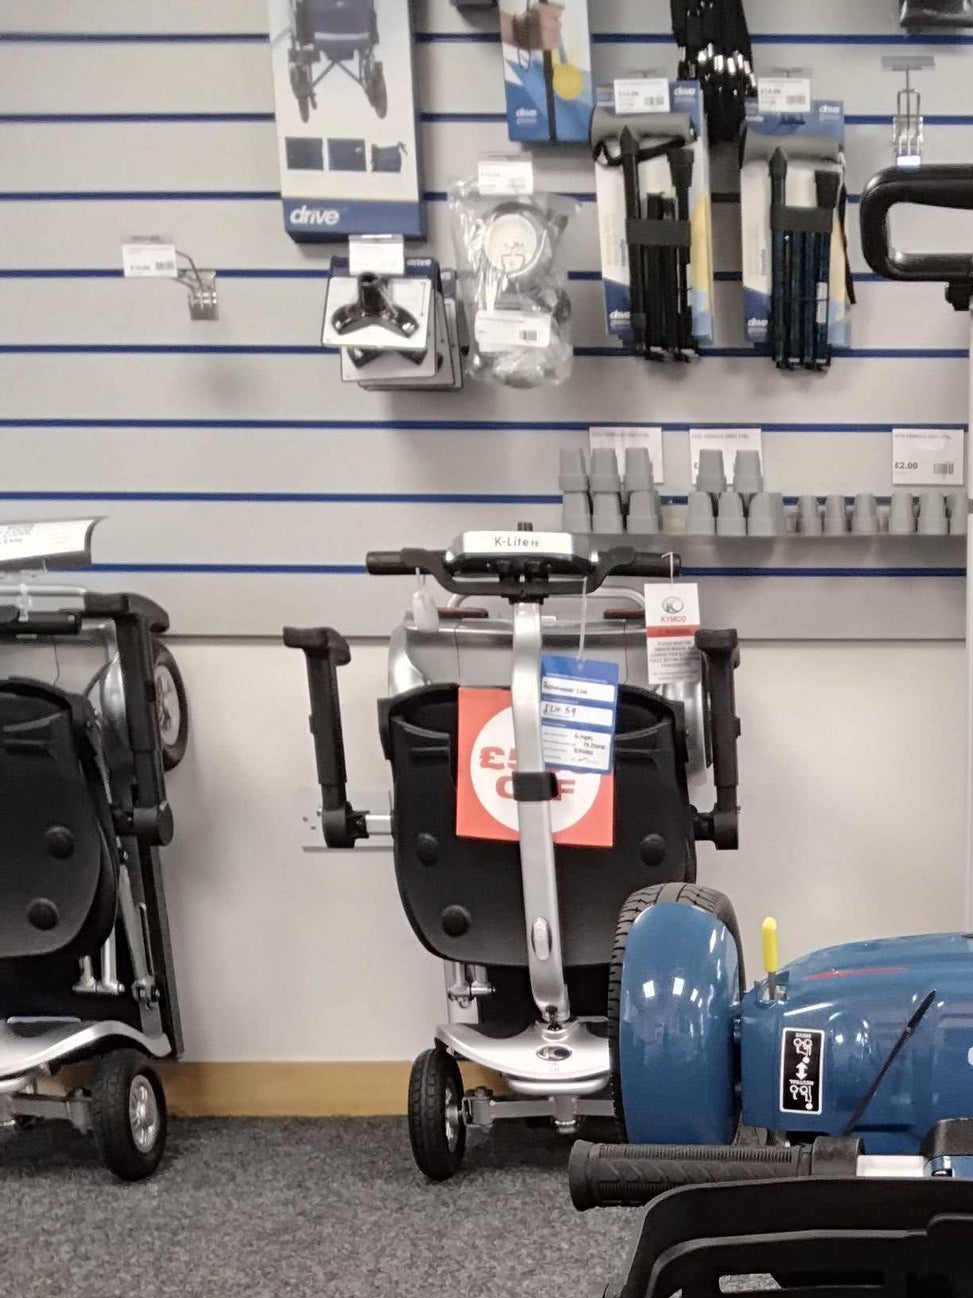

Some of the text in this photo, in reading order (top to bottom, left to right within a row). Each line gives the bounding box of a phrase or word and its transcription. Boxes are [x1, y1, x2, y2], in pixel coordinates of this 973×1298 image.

[290, 204, 340, 225] drive
[894, 461, 919, 470] £2.00
[494, 537, 529, 548] K-Lite
[660, 615, 687, 624] KYMCO
